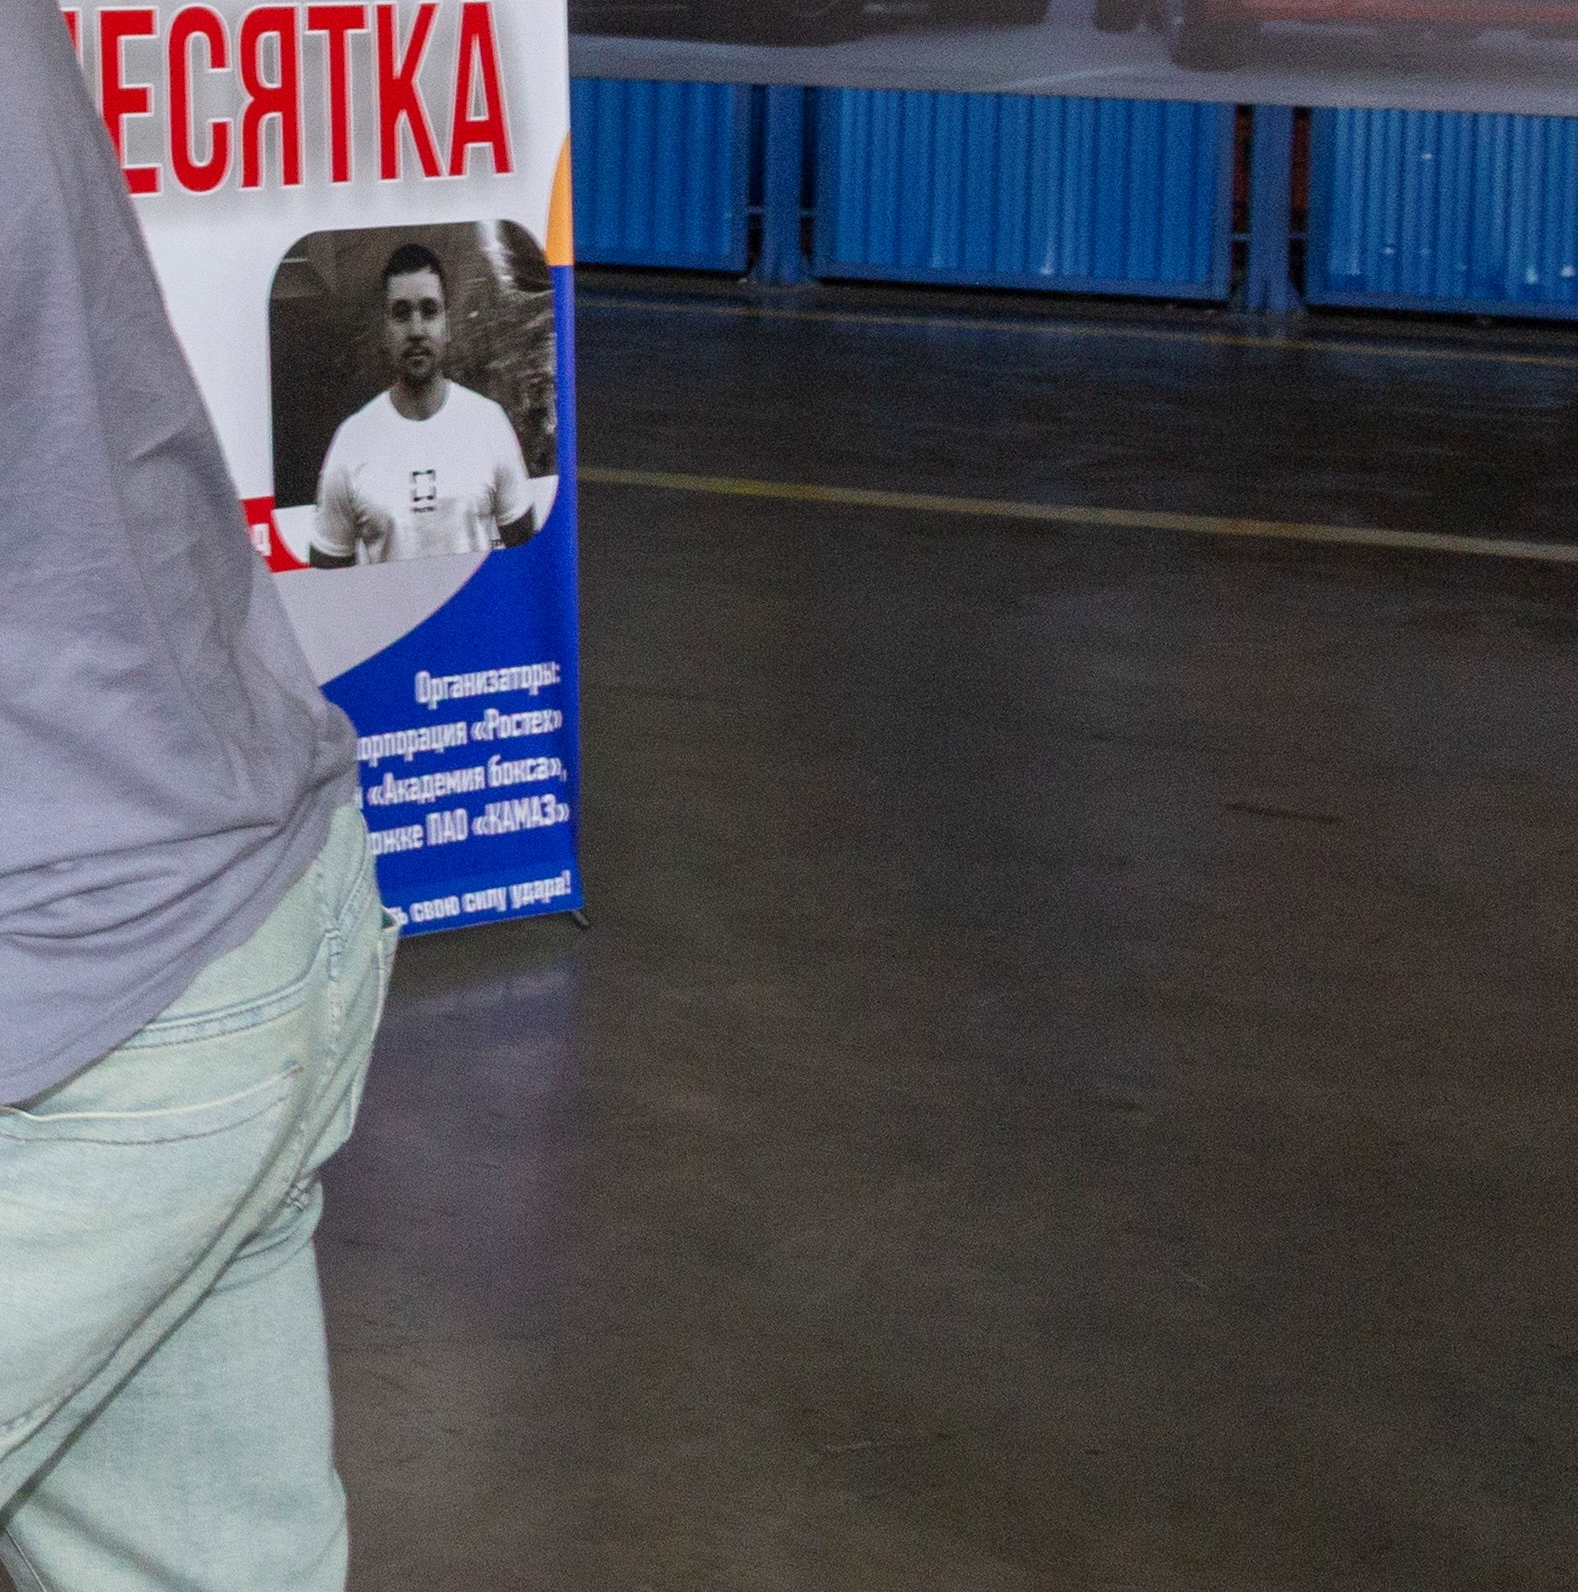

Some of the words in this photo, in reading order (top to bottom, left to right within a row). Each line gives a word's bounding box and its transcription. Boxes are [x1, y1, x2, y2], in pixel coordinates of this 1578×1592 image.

[415, 661, 561, 709] Организаторы:
[356, 720, 468, 767] орпорация
[471, 708, 563, 742] «Ростех»
[368, 765, 485, 806] «Академия
[488, 754, 567, 789] бокса»,
[425, 808, 468, 846] ПАО
[472, 793, 570, 837] «КАМАЗ»
[411, 896, 460, 923] свою
[461, 886, 507, 913] силу
[509, 870, 571, 908] удара!
